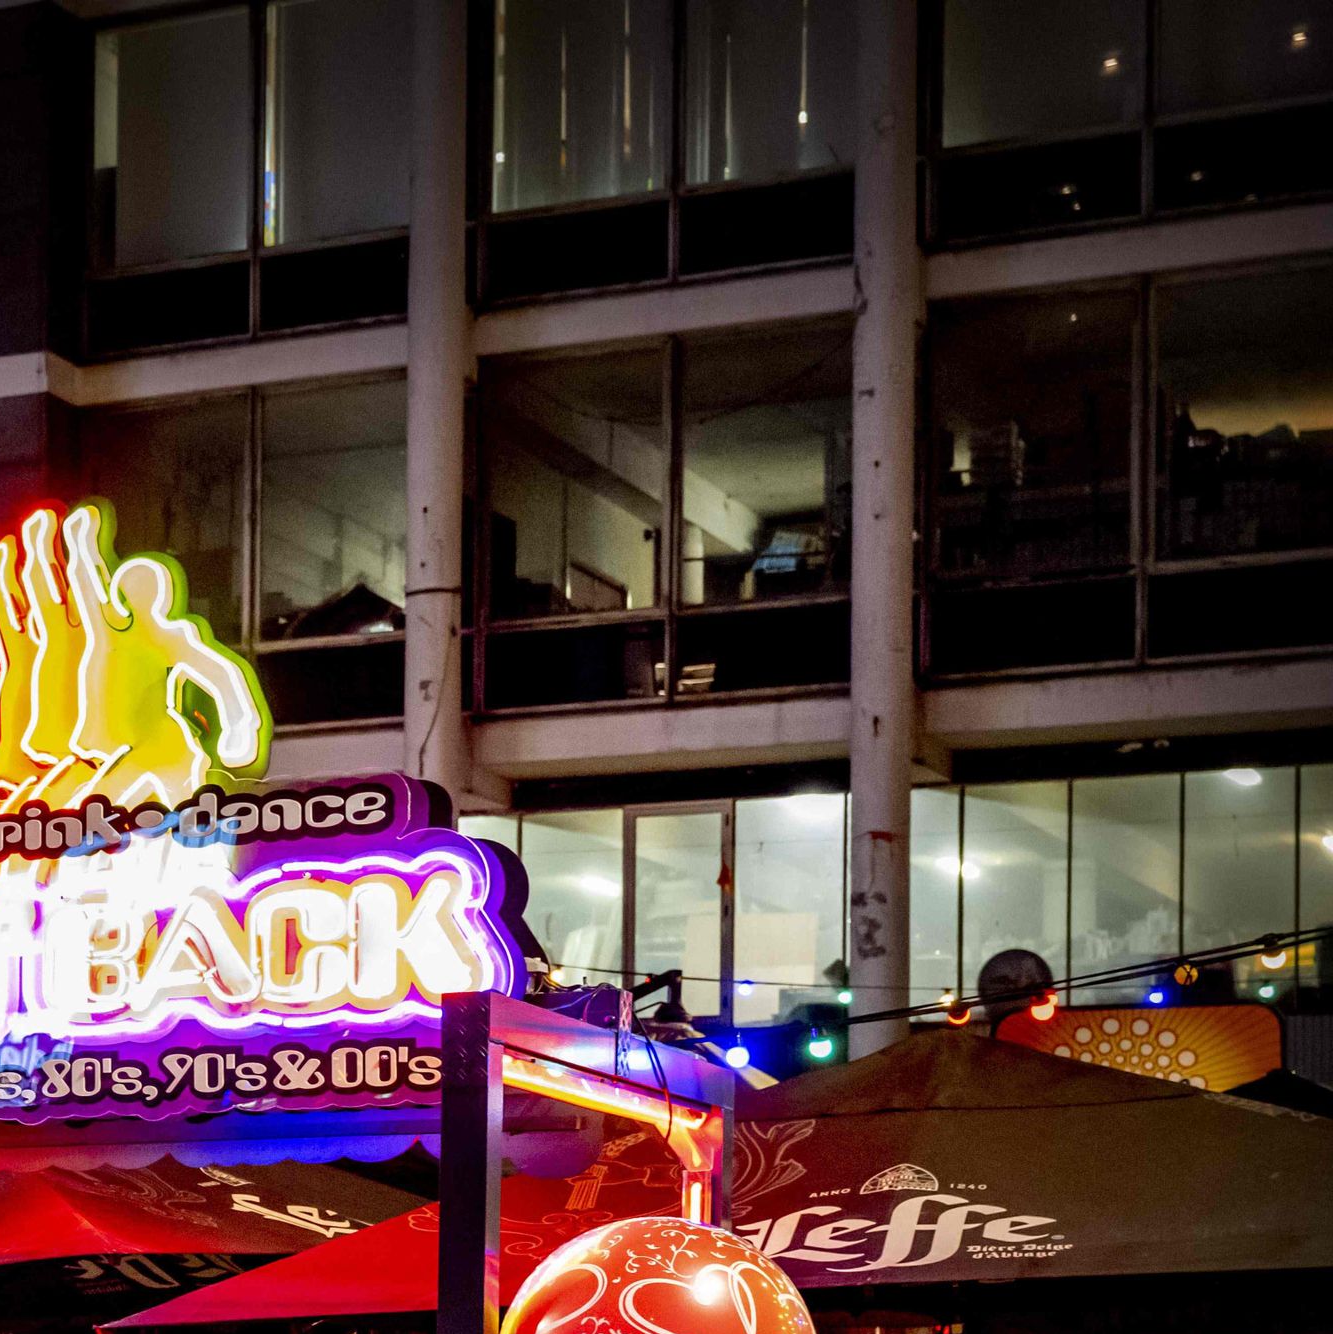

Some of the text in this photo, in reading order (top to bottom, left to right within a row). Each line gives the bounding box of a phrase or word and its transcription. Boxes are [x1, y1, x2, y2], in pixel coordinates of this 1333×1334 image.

[179, 791, 387, 837] dance
[37, 866, 481, 1020] BACK
[273, 1049, 326, 1091] &
[809, 1182, 988, 1199] ANNO 1240
[735, 1193, 1057, 1273] Leffe
